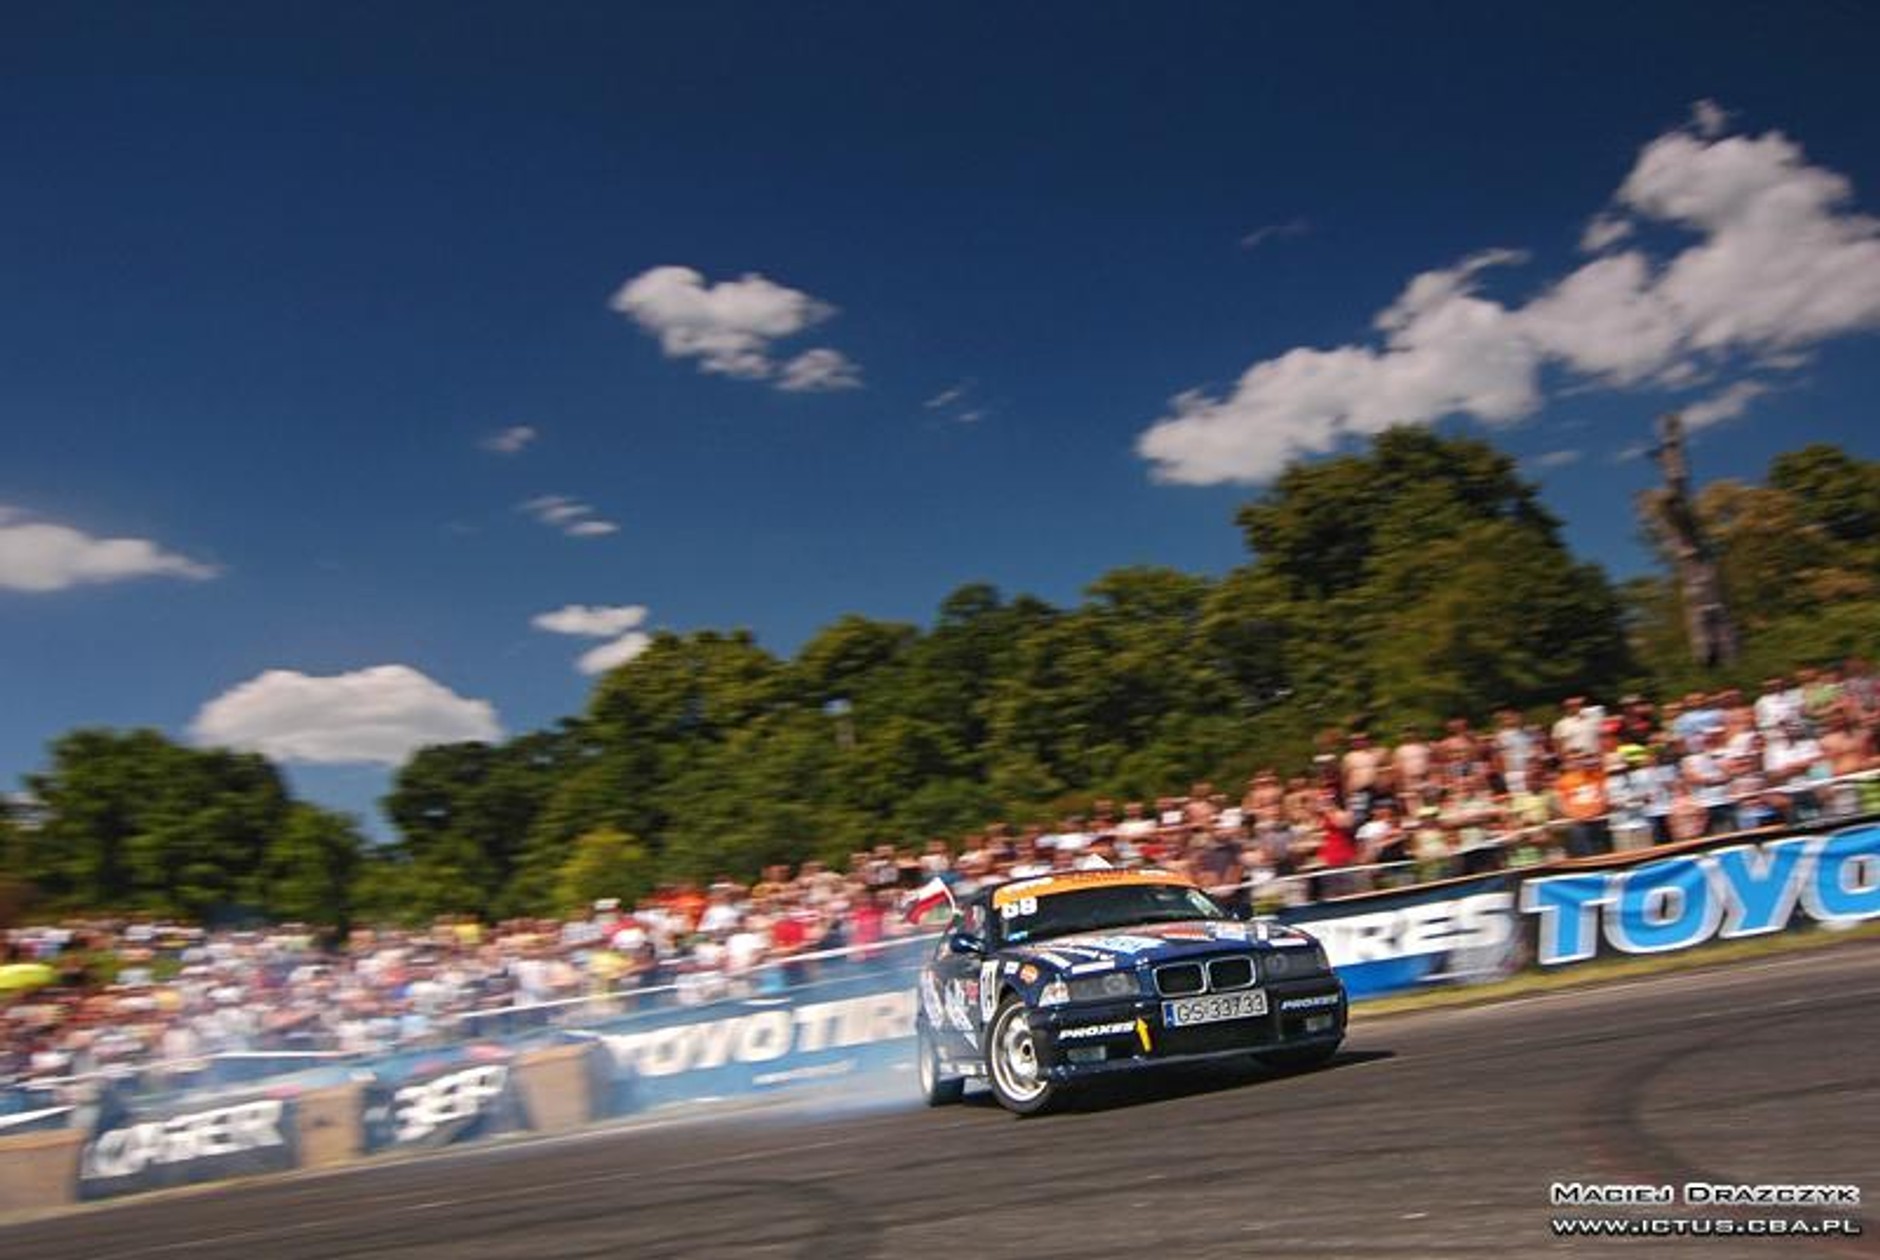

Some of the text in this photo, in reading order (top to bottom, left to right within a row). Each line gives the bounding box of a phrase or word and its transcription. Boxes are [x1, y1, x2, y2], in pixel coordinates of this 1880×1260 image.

[1519, 822, 1880, 966] TOYO
[1290, 892, 1516, 967] IRES
[793, 986, 918, 1052] TIR
[1058, 1020, 1136, 1041] PROXES
